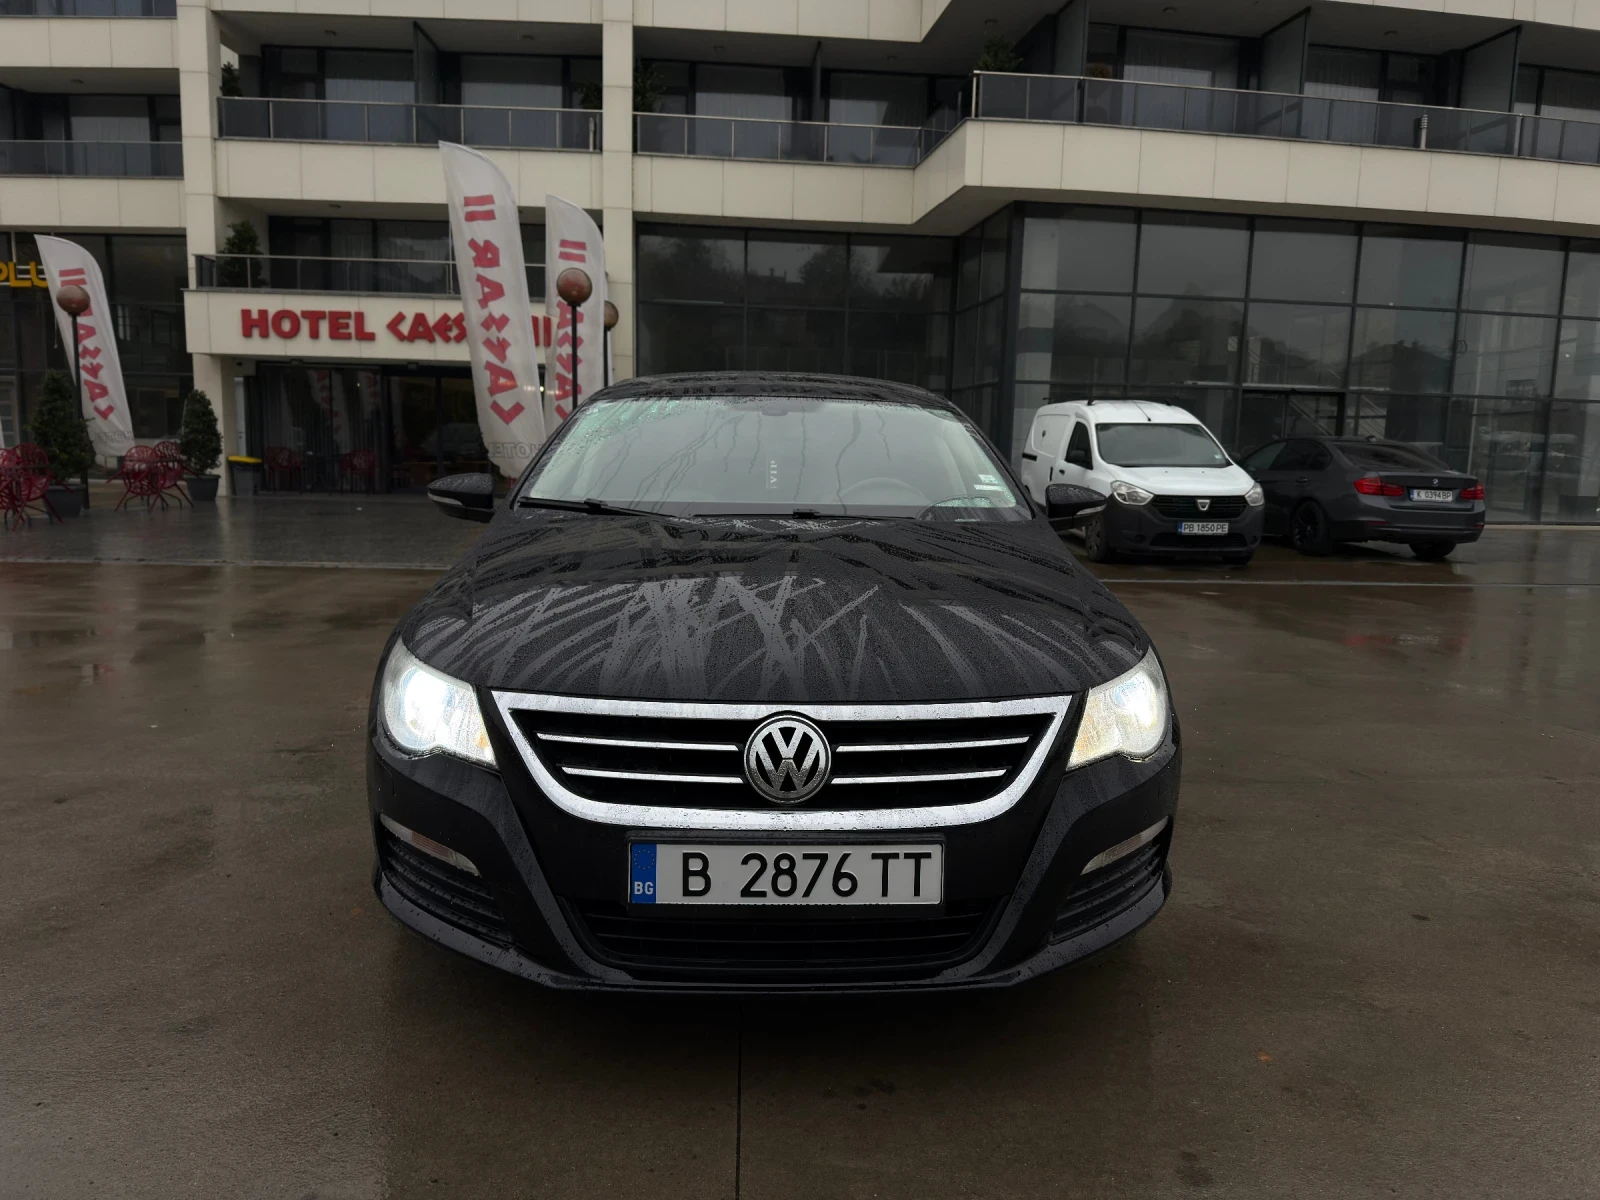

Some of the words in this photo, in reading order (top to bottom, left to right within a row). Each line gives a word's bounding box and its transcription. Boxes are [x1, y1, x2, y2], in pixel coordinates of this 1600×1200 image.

[241, 309, 375, 341] HOTEL
[386, 312, 467, 343] CAES
[1183, 523, 1194, 532] PB
[1197, 523, 1215, 532] 1850
[1216, 523, 1227, 532] PE
[682, 852, 712, 897] B
[740, 852, 858, 898] 2876
[871, 852, 932, 897] TT
[634, 881, 654, 895] BG
